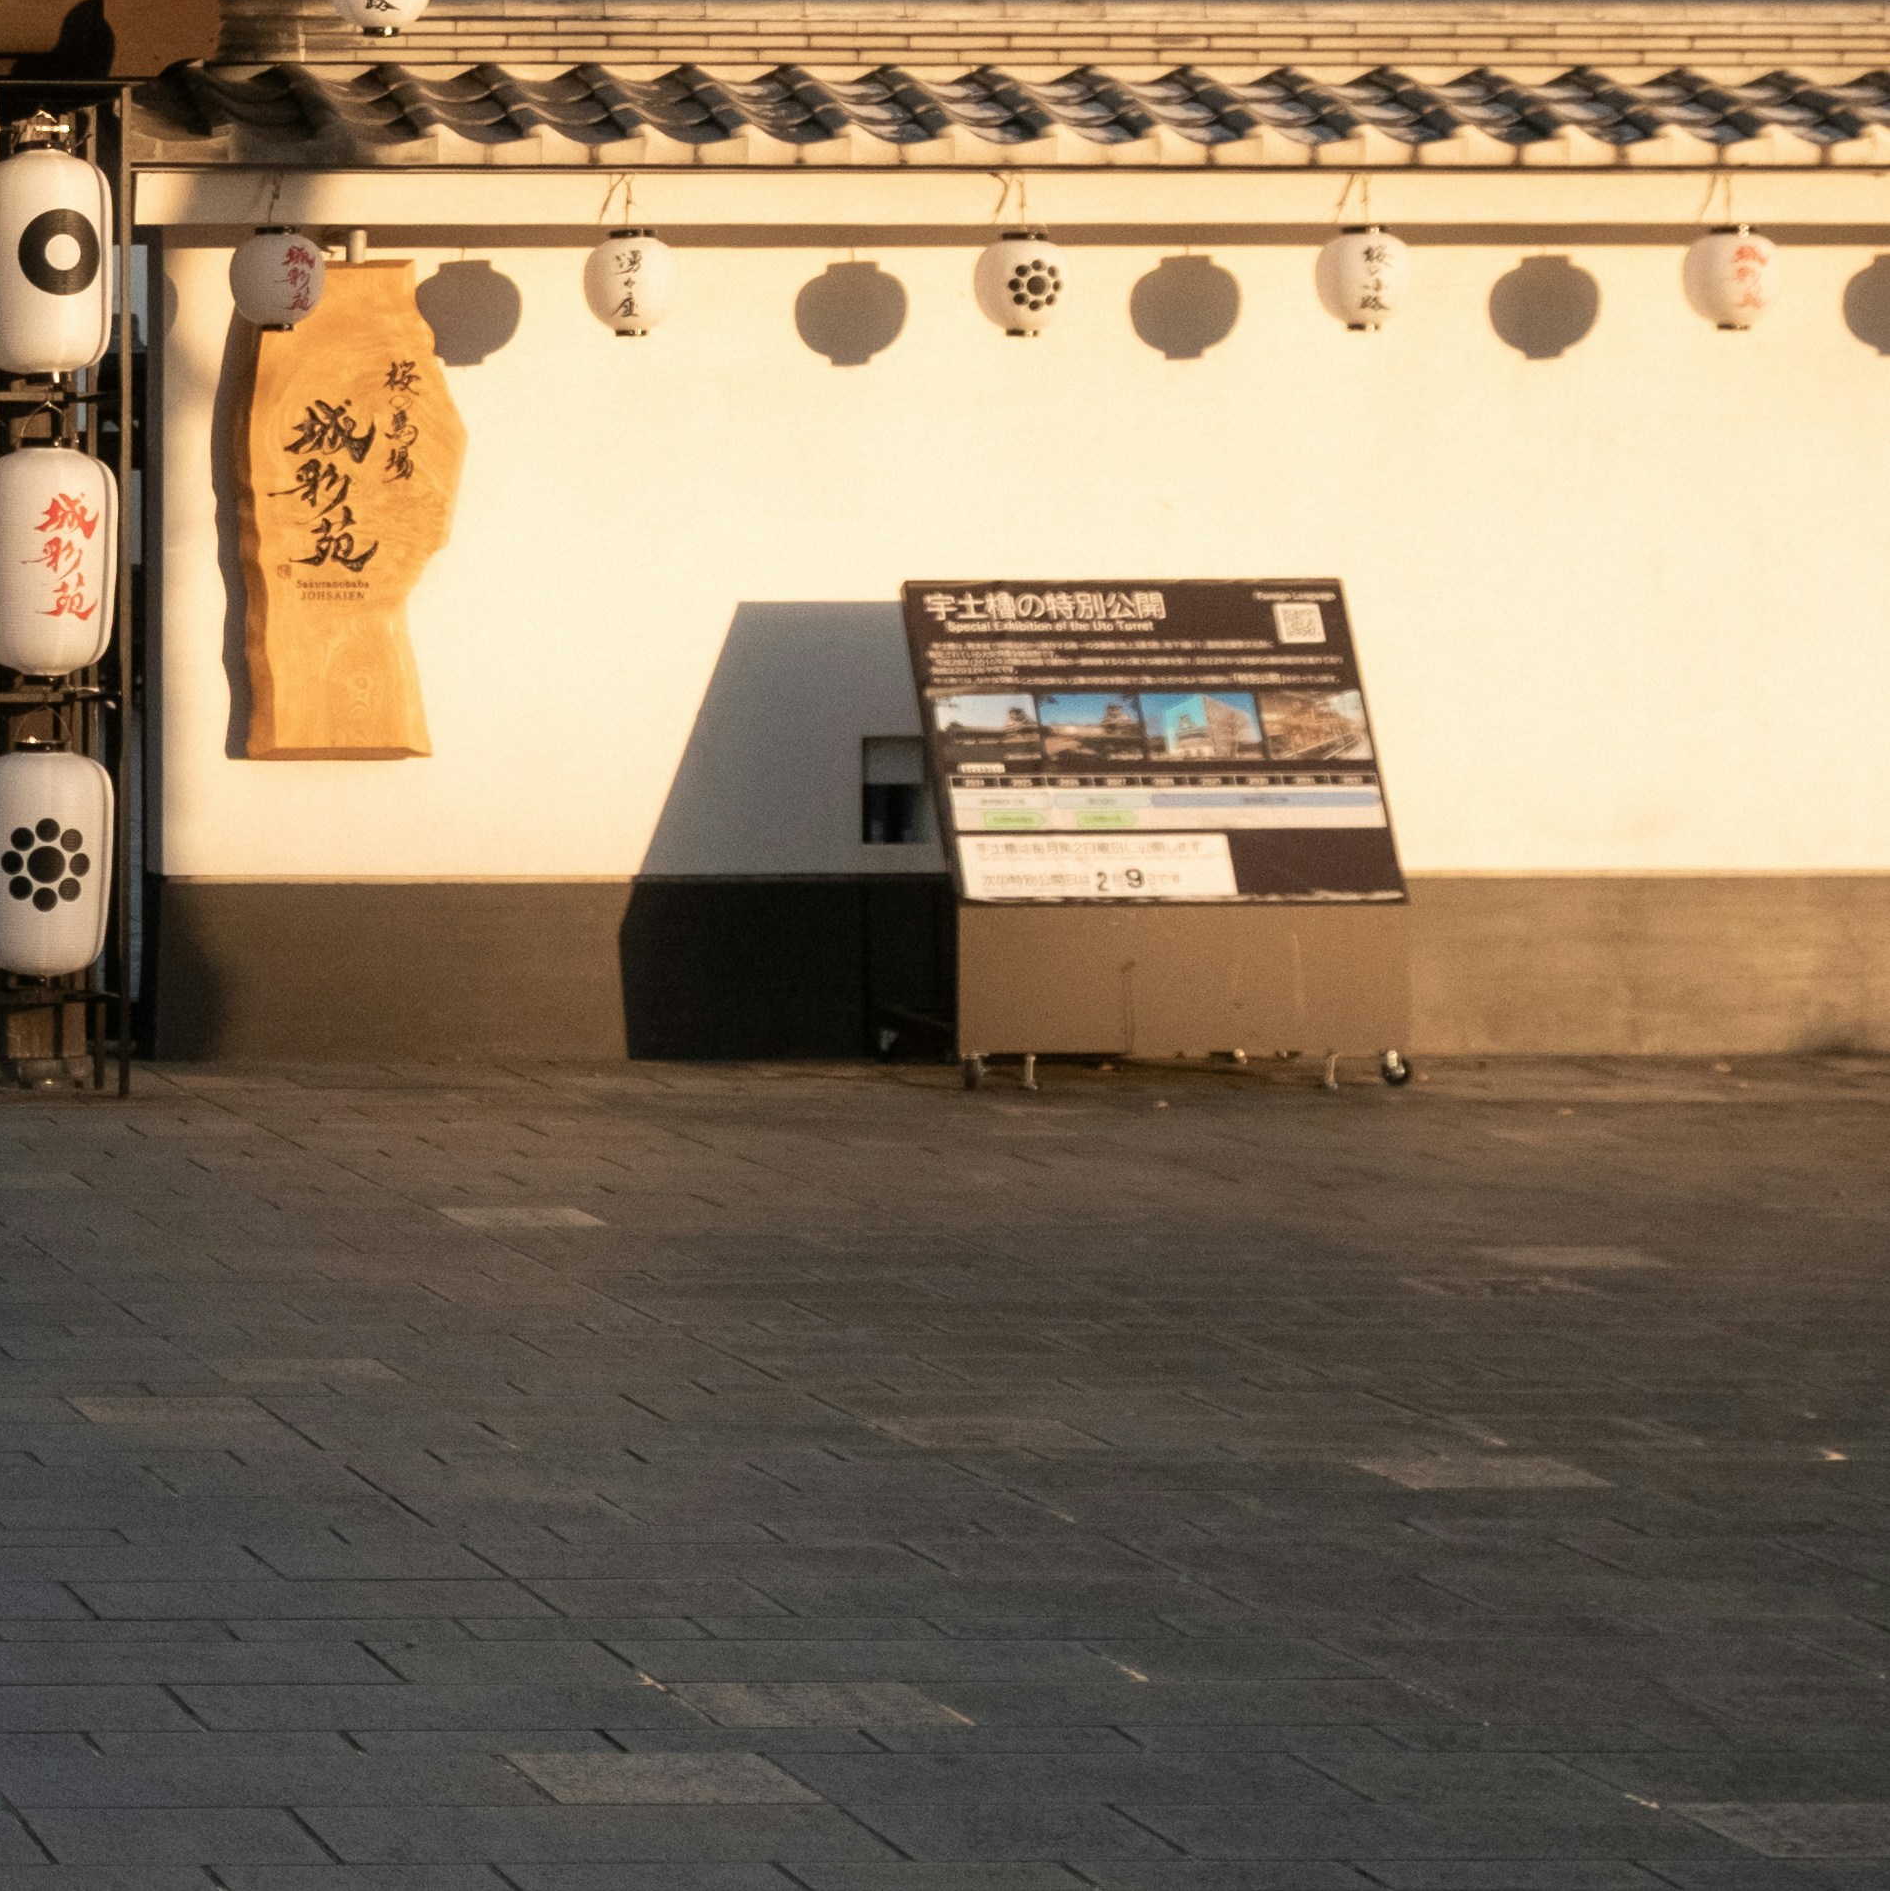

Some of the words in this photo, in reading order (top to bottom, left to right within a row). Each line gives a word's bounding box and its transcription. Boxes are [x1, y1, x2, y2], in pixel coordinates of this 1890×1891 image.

[275, 244, 316, 312] 城彩苑
[384, 361, 423, 485] 桜の馬場
[268, 398, 379, 574] 城彩苑
[21, 493, 100, 621] 城彩苑
[296, 580, 369, 589] Sakuranobaba
[300, 591, 365, 601] JOHSAIEN
[923, 591, 1167, 621] 宇土櫓の特別公開
[944, 621, 991, 634] Special
[996, 620, 1053, 631] Exhibition
[1055, 620, 1068, 631] of
[1070, 620, 1090, 631] the
[1092, 621, 1115, 631] Uto
[1117, 620, 1155, 631] Turret
[1095, 871, 1110, 892] 2
[1125, 868, 1146, 889] 9
